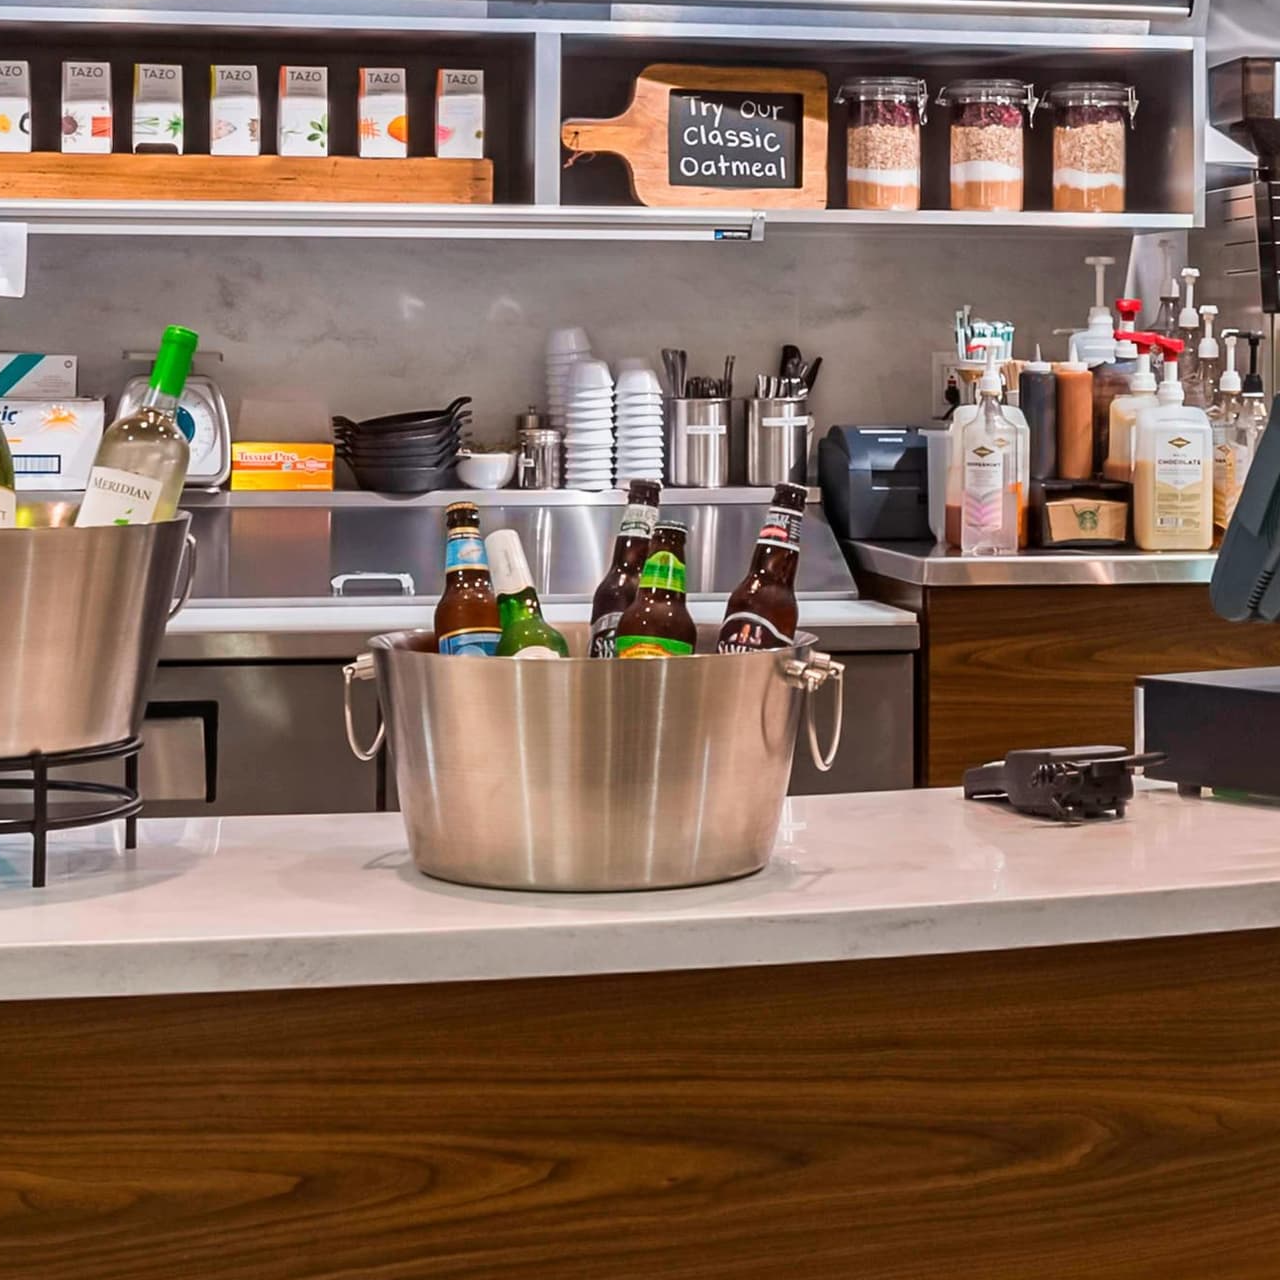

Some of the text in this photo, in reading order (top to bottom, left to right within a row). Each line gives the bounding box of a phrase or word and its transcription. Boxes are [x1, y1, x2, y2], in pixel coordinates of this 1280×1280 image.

[70, 66, 103, 78] TAZO
[142, 68, 176, 80] TAZO
[219, 70, 252, 81] TAZO
[290, 71, 322, 82] TAZO
[368, 73, 400, 84] TAZO
[445, 73, 477, 85] TAZO
[682, 96, 784, 127] Try Our
[680, 154, 786, 179] Oatmeal
[93, 476, 153, 501] MERIDIAN
